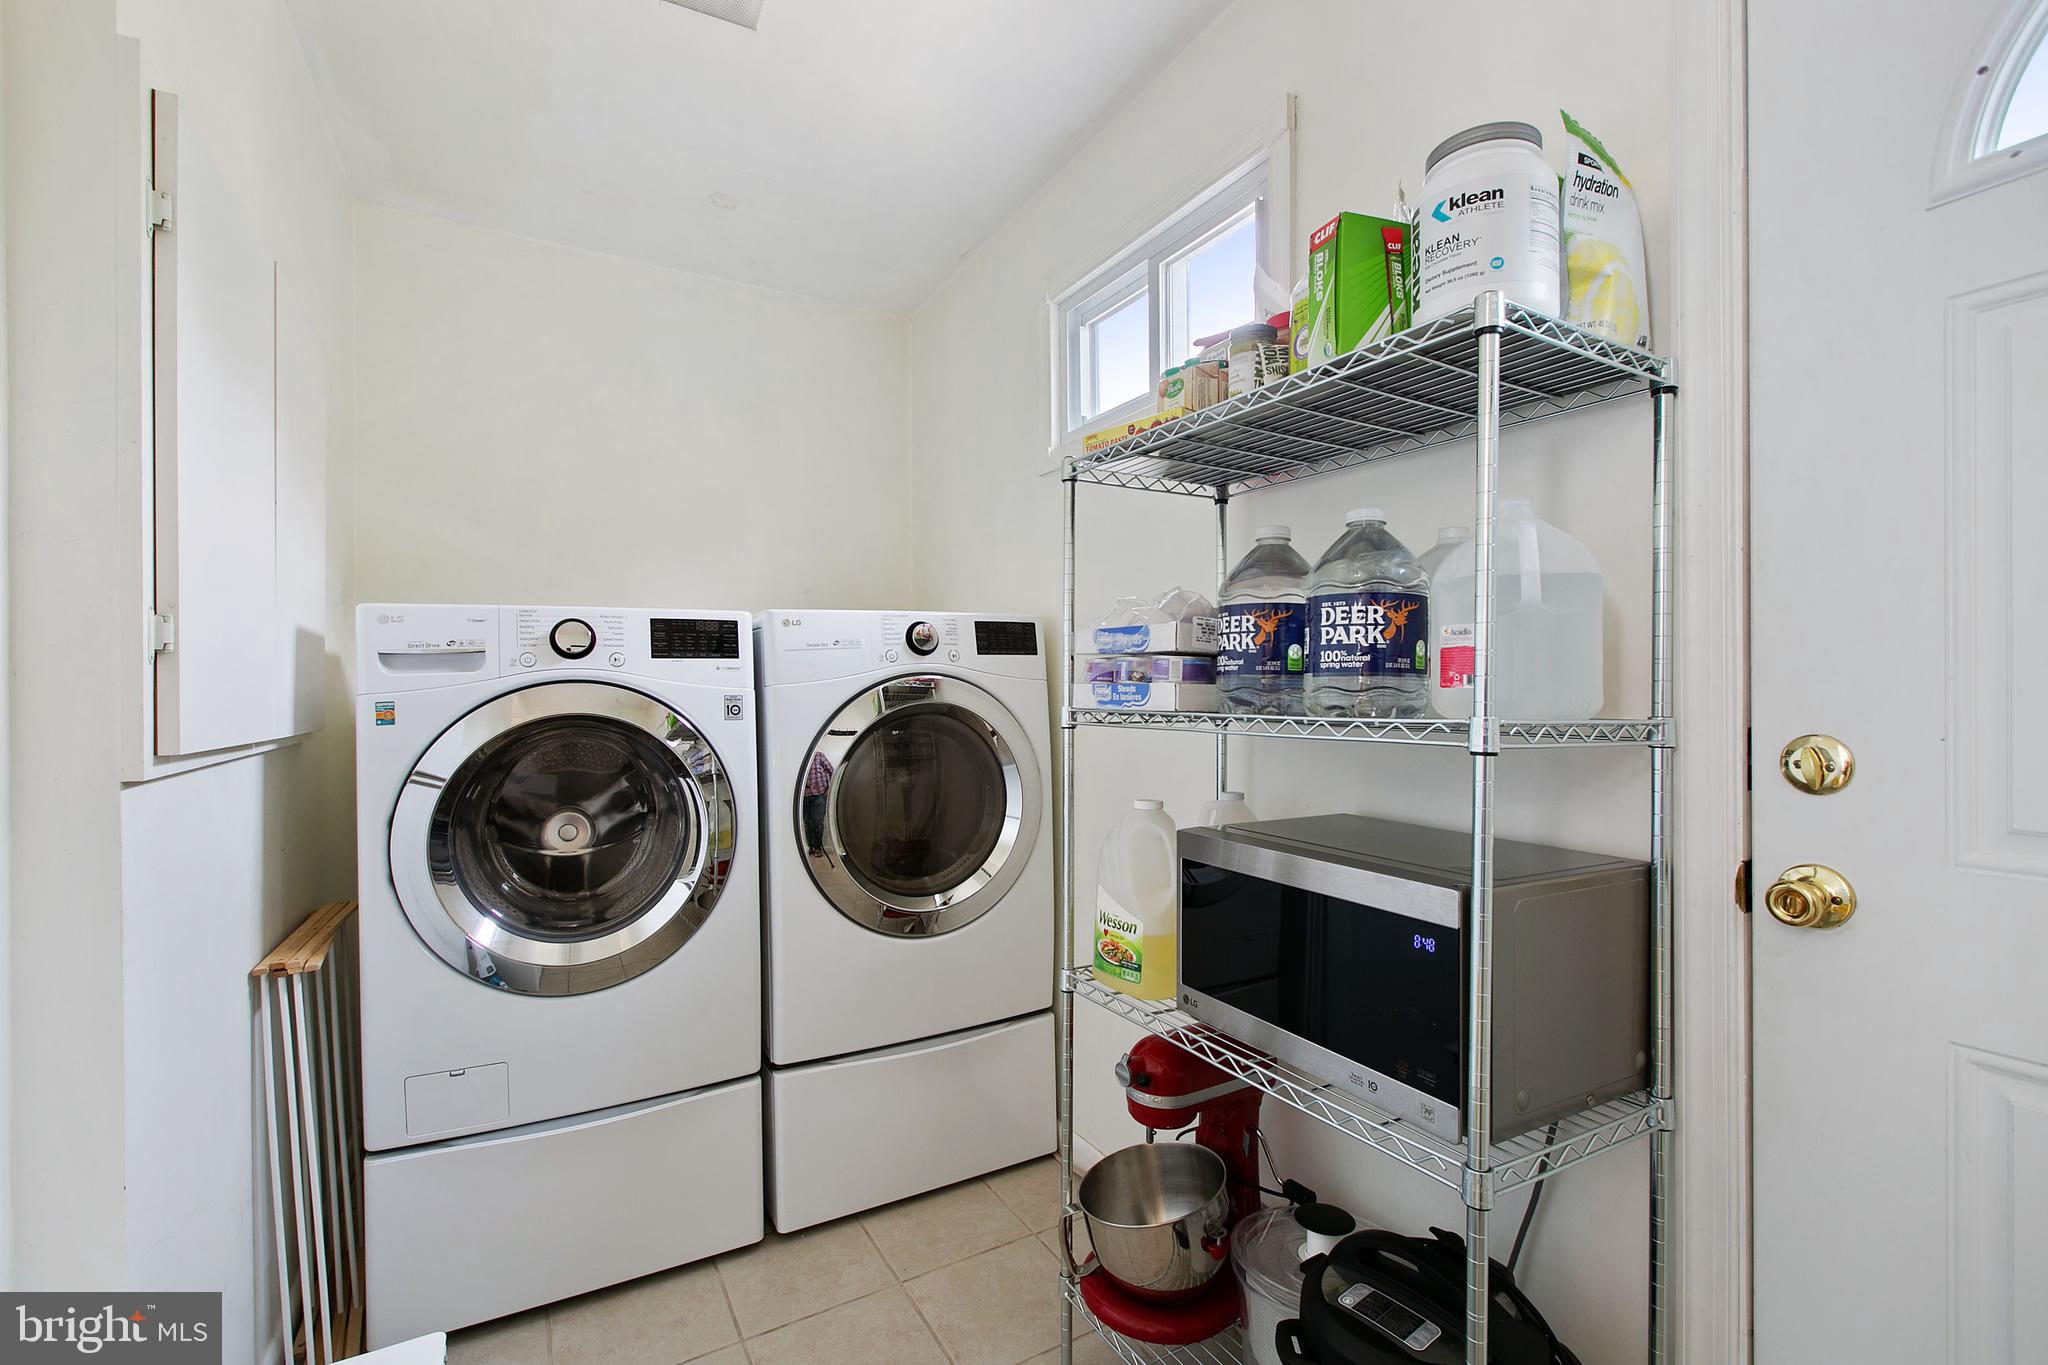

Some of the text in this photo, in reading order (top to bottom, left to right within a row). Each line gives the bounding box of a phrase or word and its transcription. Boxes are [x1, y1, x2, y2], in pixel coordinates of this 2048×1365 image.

[1573, 170, 1619, 199] hydration
[1449, 188, 1504, 211] klean
[1458, 201, 1504, 216] ATHLETE
[1570, 192, 1589, 210] drink
[1590, 201, 1604, 213] mix
[1314, 221, 1336, 245] CLIF
[1425, 233, 1460, 256] KLEAN
[1425, 237, 1479, 265] RECOVERY
[1316, 251, 1324, 302] BLOKS
[1442, 260, 1478, 275] Supplement
[1394, 261, 1404, 300] BLOKS
[1216, 615, 1256, 634] DEER
[1320, 604, 1386, 626] DEER
[1217, 632, 1257, 652] PARK
[1320, 625, 1386, 647] PARK
[1320, 650, 1347, 663] 100%
[1320, 662, 1340, 670] spring
[1099, 908, 1138, 935] Wesson
[1189, 998, 1198, 1008] LG
